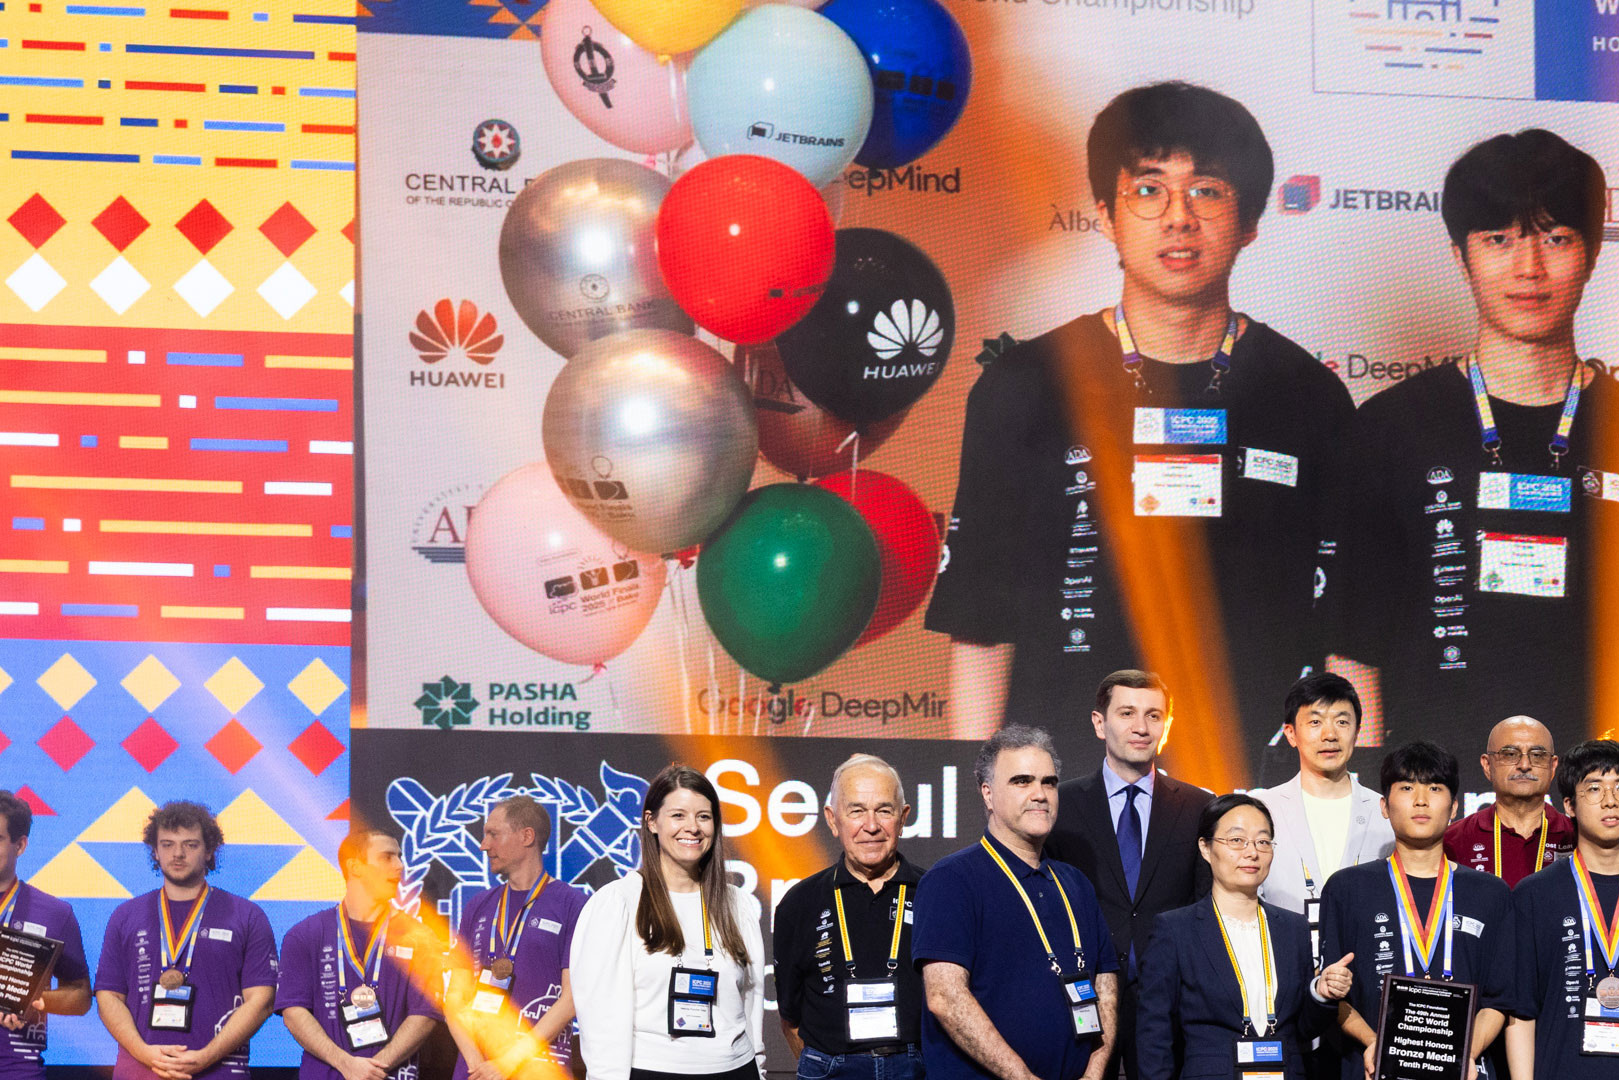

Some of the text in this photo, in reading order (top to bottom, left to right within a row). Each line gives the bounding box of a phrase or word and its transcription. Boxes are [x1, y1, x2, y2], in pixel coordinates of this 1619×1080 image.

[775, 131, 845, 148] JETBRAINS
[405, 173, 516, 194] CENTRAL
[844, 166, 961, 196] epMind
[406, 195, 421, 206] OF
[424, 196, 445, 206] THE
[449, 197, 502, 208] REPUBLIC
[1328, 188, 1443, 213] JETBRAI
[1347, 354, 1463, 380] Deep
[410, 371, 504, 389] HUAWEI
[489, 682, 577, 701] PASHA
[821, 691, 948, 724] DeepMi
[489, 704, 592, 731] Holding
[704, 758, 957, 838] Seul
[1397, 1022, 1454, 1037] Championship
[1404, 1015, 1449, 1027] ICPC World
[1394, 1036, 1454, 1050] Highest Honors
[1388, 1046, 1456, 1063] Bronze Medal
[1398, 1059, 1444, 1072] Tenth Place
